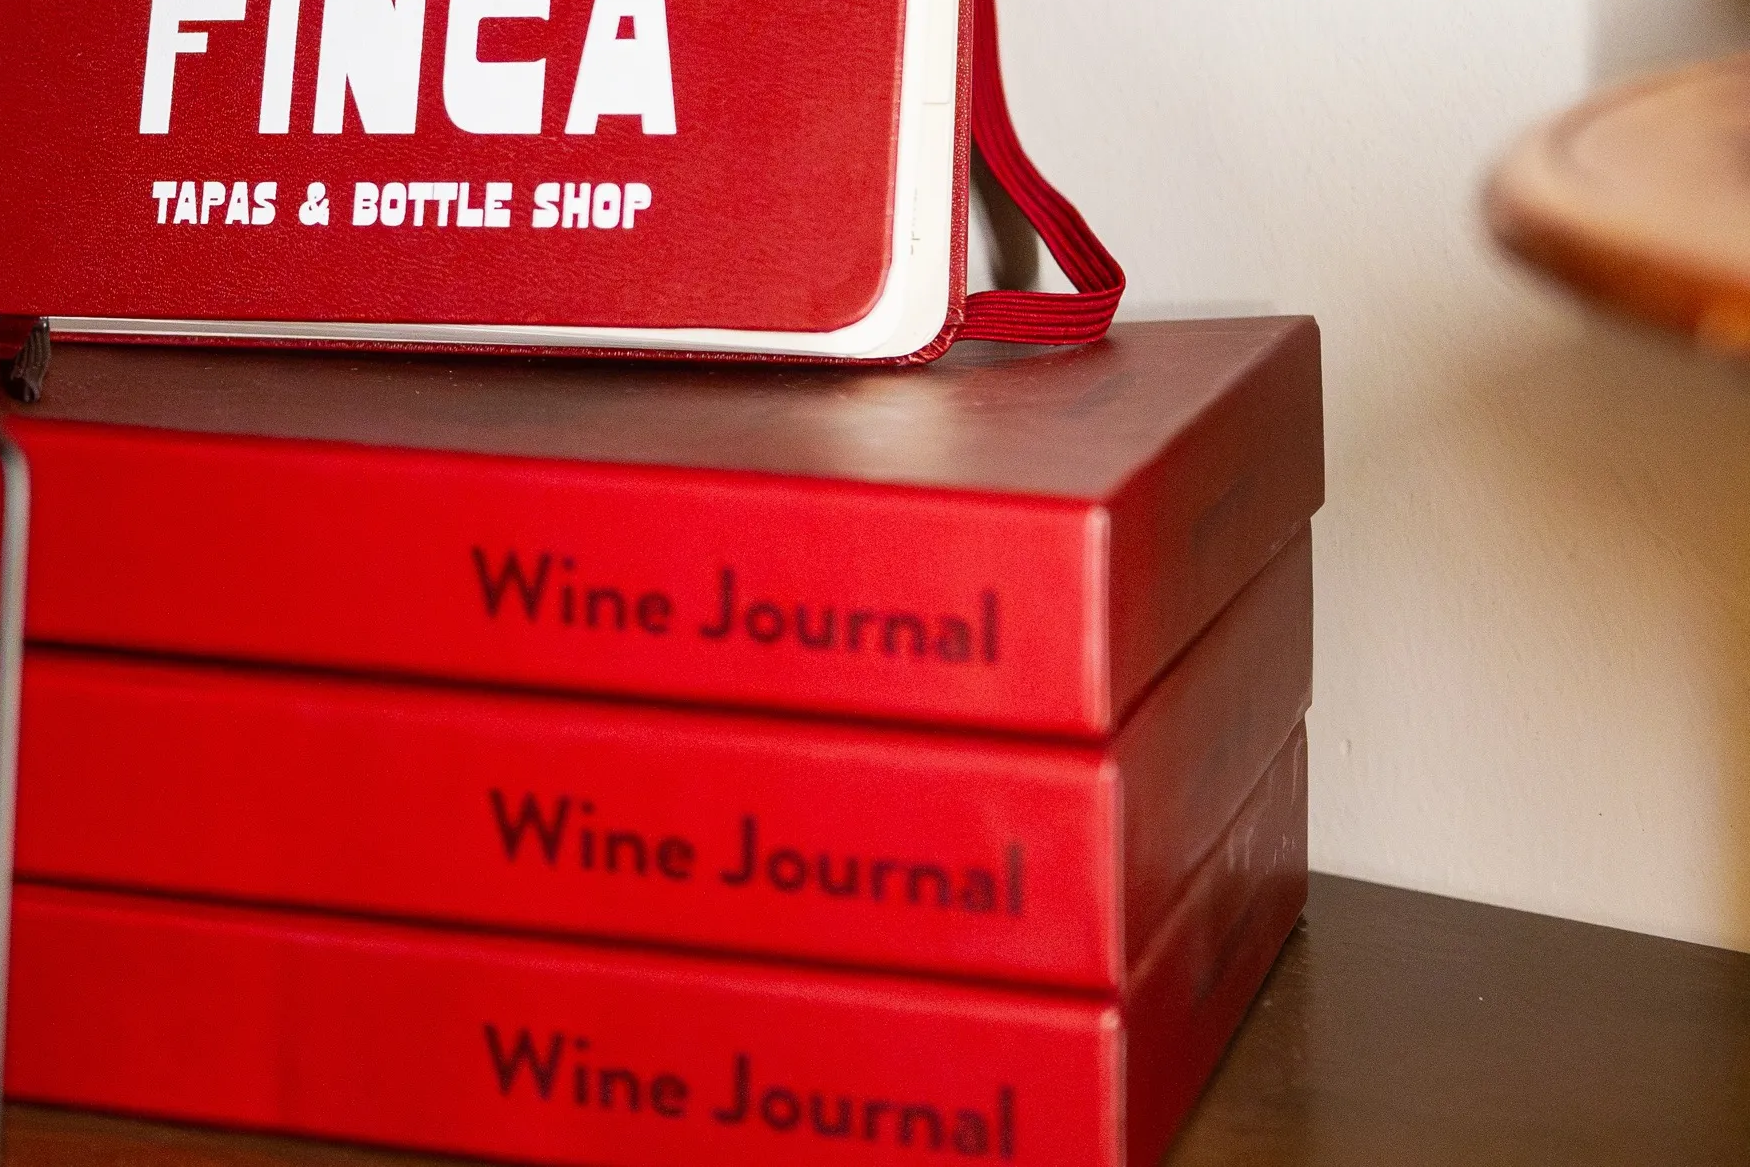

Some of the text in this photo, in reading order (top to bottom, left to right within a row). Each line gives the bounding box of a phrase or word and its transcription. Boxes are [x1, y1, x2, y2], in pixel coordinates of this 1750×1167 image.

[152, 180, 652, 230] TAPAS & BOTTLE SHOP
[471, 546, 1002, 665] Wine Journal
[488, 788, 1025, 915] Wine Journal
[483, 1022, 1019, 1159] Wine Journal
